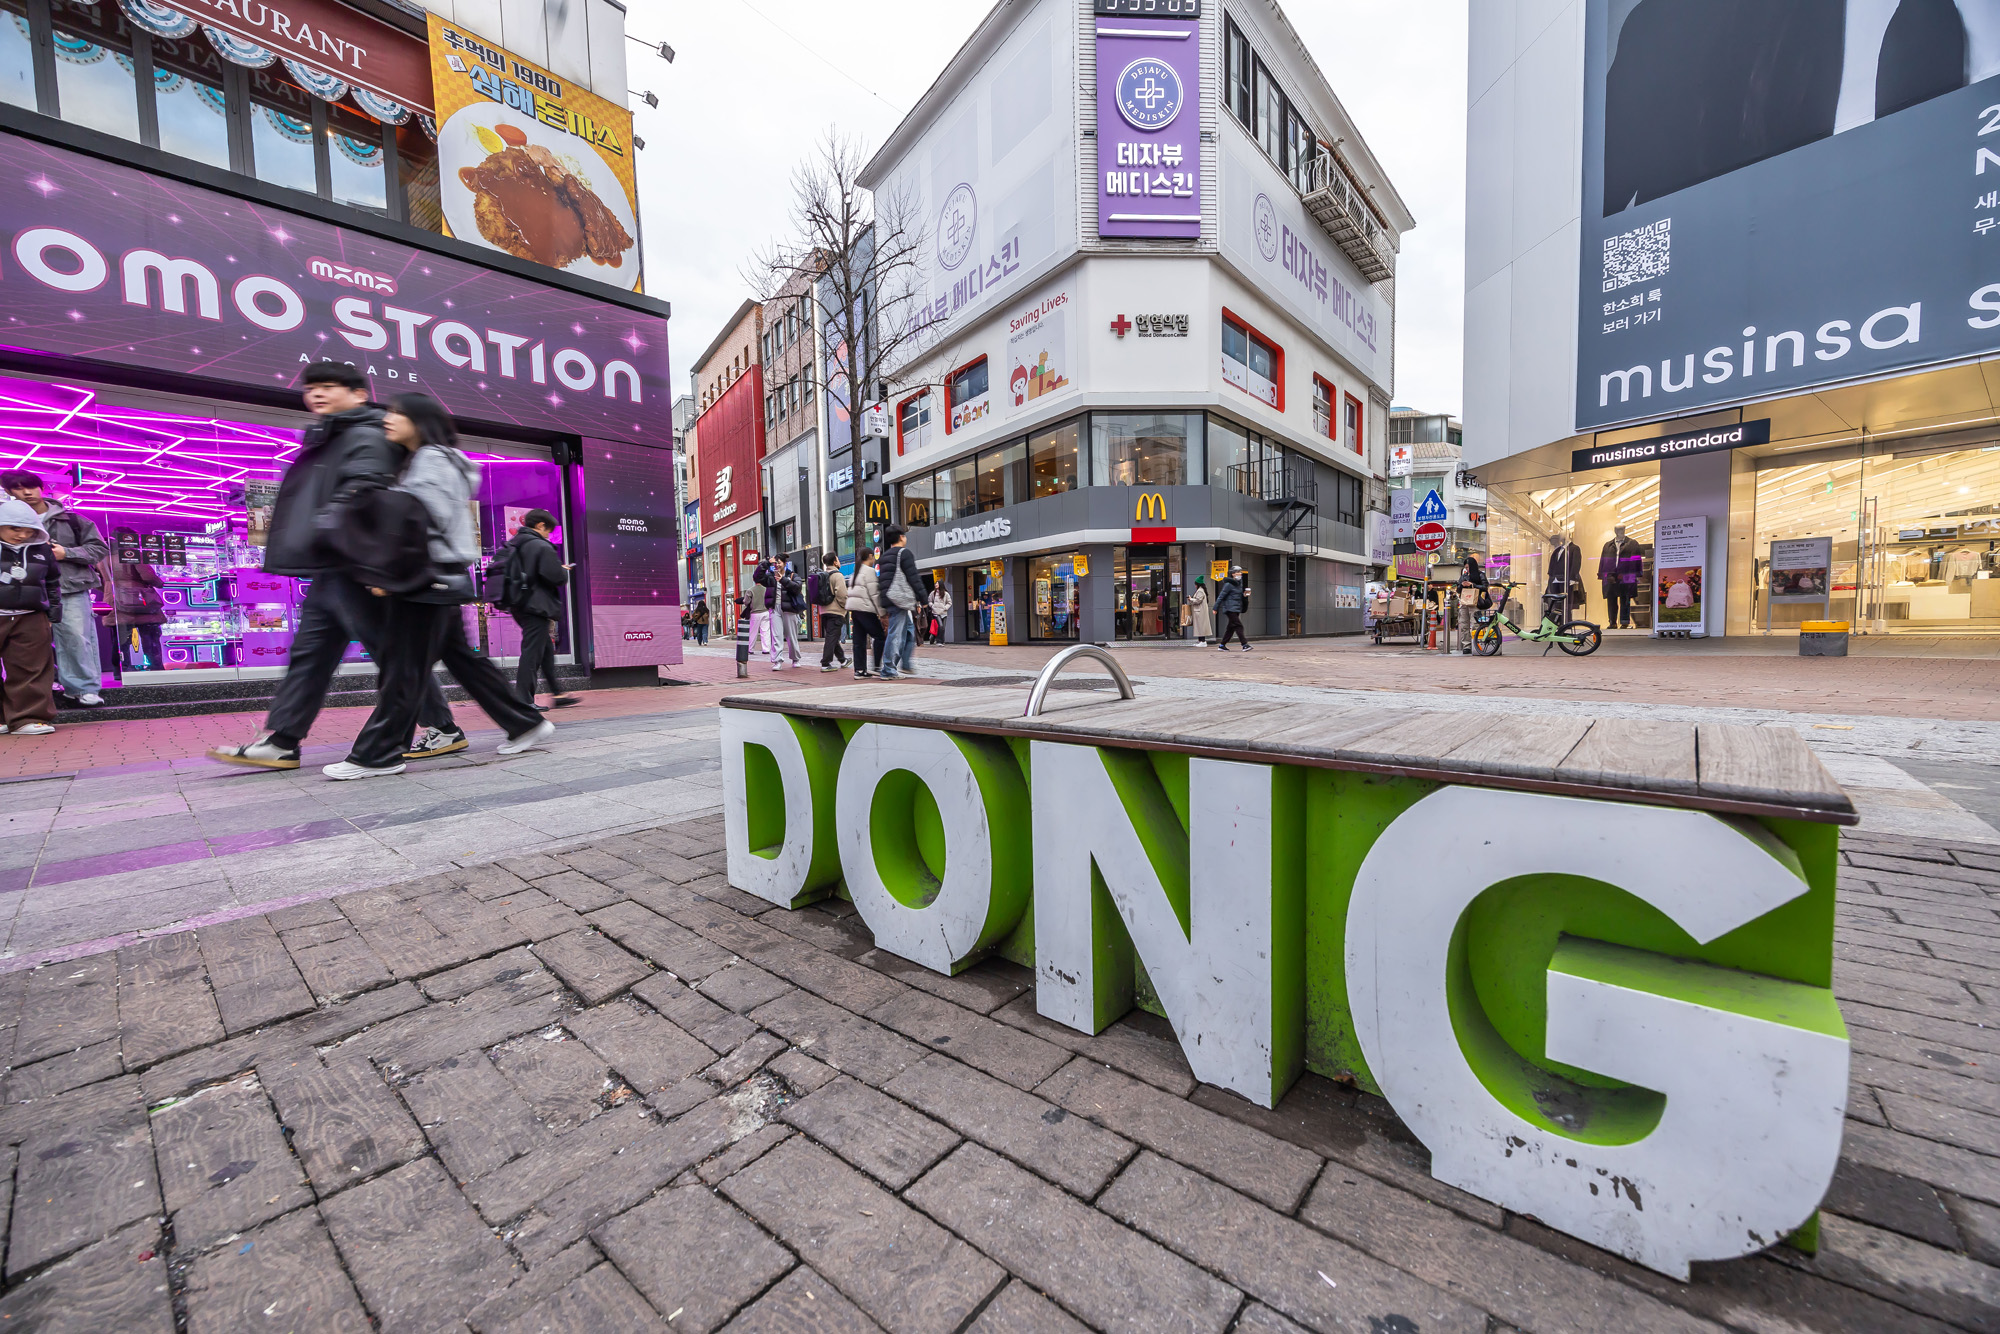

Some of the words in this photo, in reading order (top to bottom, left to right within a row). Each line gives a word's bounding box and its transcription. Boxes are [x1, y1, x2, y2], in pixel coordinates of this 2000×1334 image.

[442, 27, 507, 74] 추억의
[511, 60, 562, 98] 1980
[1130, 66, 1168, 80] DEJAVU
[1125, 100, 1174, 121] MEDISKIN
[1117, 142, 1184, 167] 데자뷰
[1106, 171, 1194, 197] 메디스킨
[953, 236, 1020, 311] 메디스킨
[1282, 224, 1328, 305] 데자뷰
[1332, 276, 1377, 354] 메디스킨
[1009, 308, 1040, 334] Saving
[1041, 292, 1069, 315] Lives,
[1602, 293, 1644, 316] 한소희
[1647, 288, 1663, 302] 룩
[1135, 313, 1190, 332] 헌혈의집
[1602, 316, 1629, 335] 보러
[1633, 307, 1661, 325] 가기
[1599, 301, 1922, 407] musinsa
[1591, 444, 1656, 464] musinsa
[1660, 427, 1743, 453] standard
[934, 517, 1011, 550] McDonald's
[720, 708, 1850, 1281] DONG
